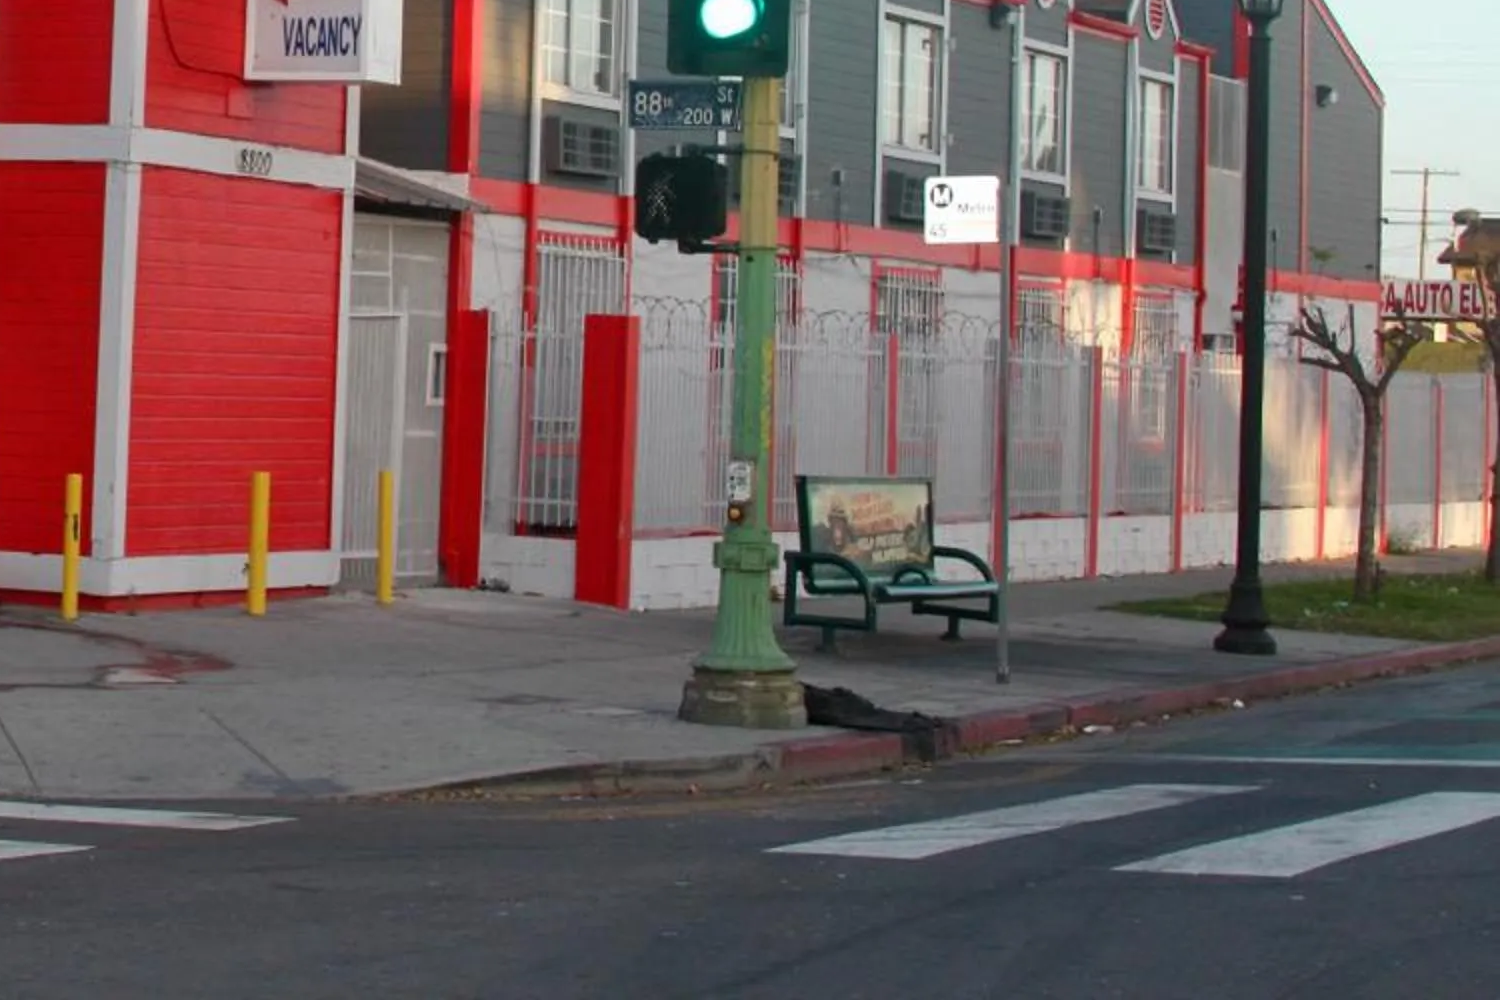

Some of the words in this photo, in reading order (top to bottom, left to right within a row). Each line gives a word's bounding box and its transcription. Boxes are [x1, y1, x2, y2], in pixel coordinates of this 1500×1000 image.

[282, 13, 362, 56] VACANCY
[717, 86, 734, 103] St
[683, 107, 713, 125] 200
[721, 108, 732, 125] W
[1403, 283, 1453, 314] AUTO
